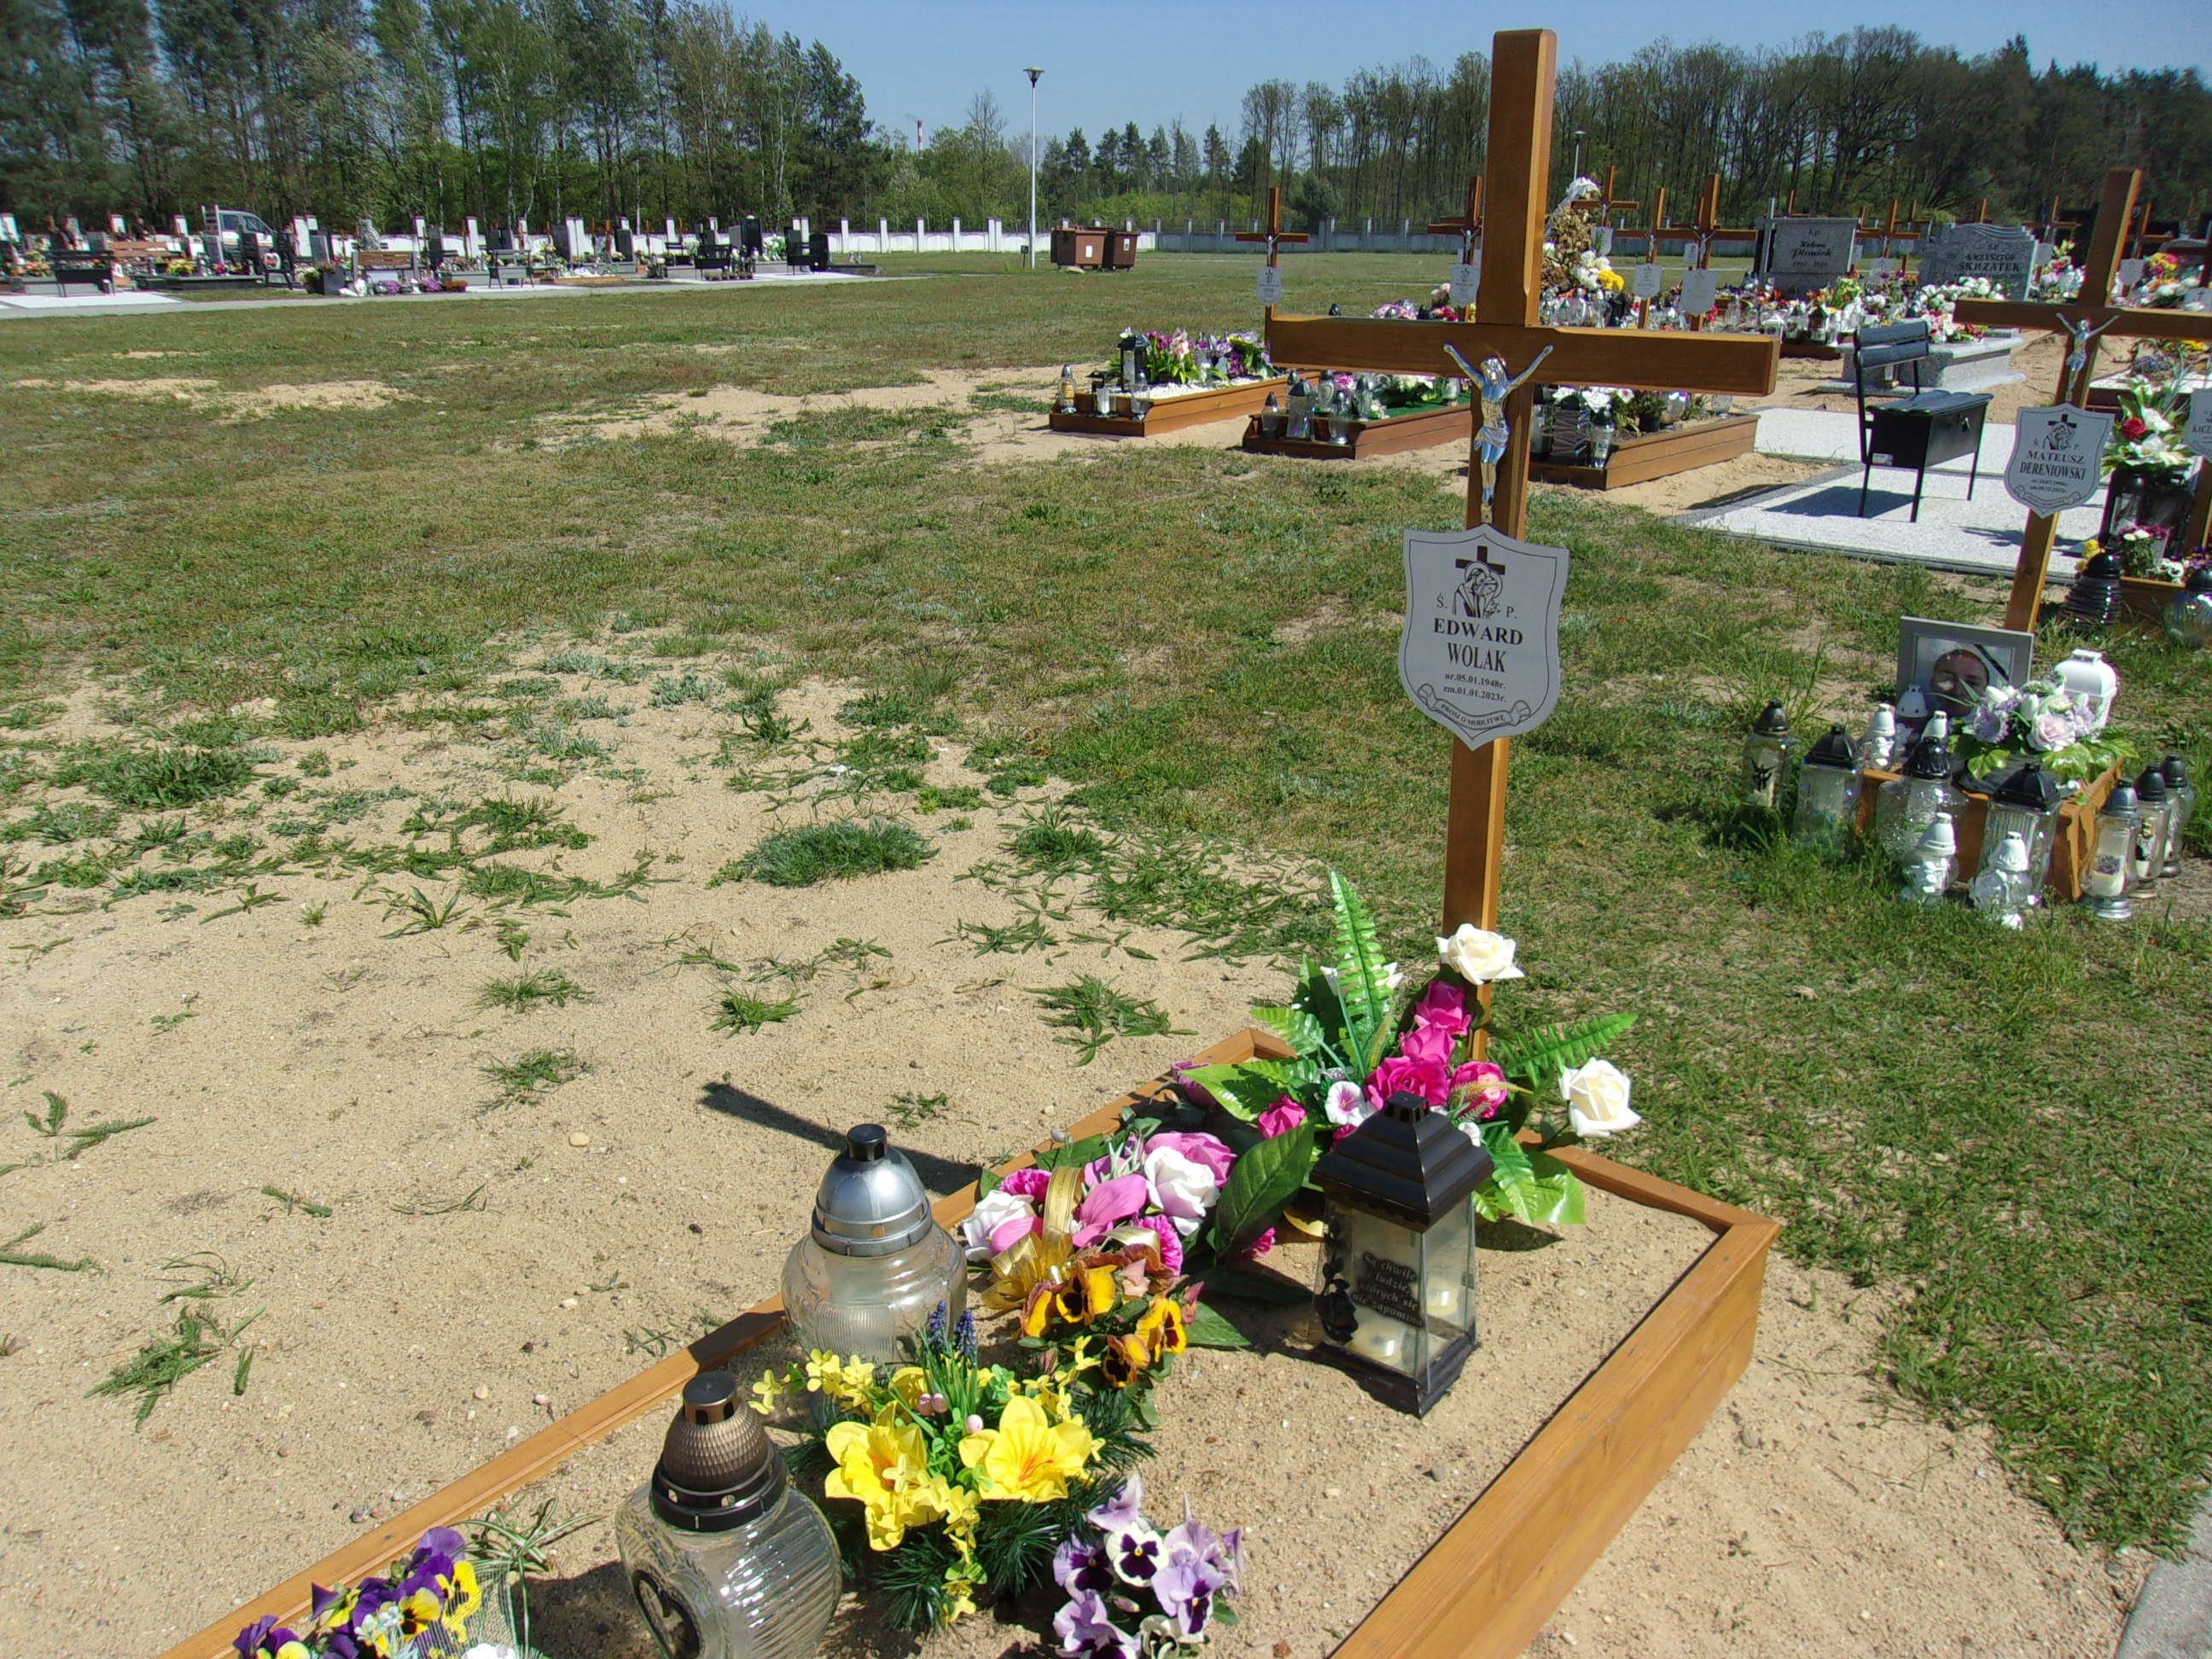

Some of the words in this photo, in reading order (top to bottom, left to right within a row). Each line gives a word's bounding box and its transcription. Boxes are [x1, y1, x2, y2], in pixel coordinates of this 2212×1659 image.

[2026, 450, 2085, 464] MATEUSZ
[2019, 462, 2086, 480] DERENIOWSKI
[1434, 617, 1523, 646] EDWARD
[1447, 642, 1506, 672] WOLAK
[1381, 1262, 1416, 1280] chwile
